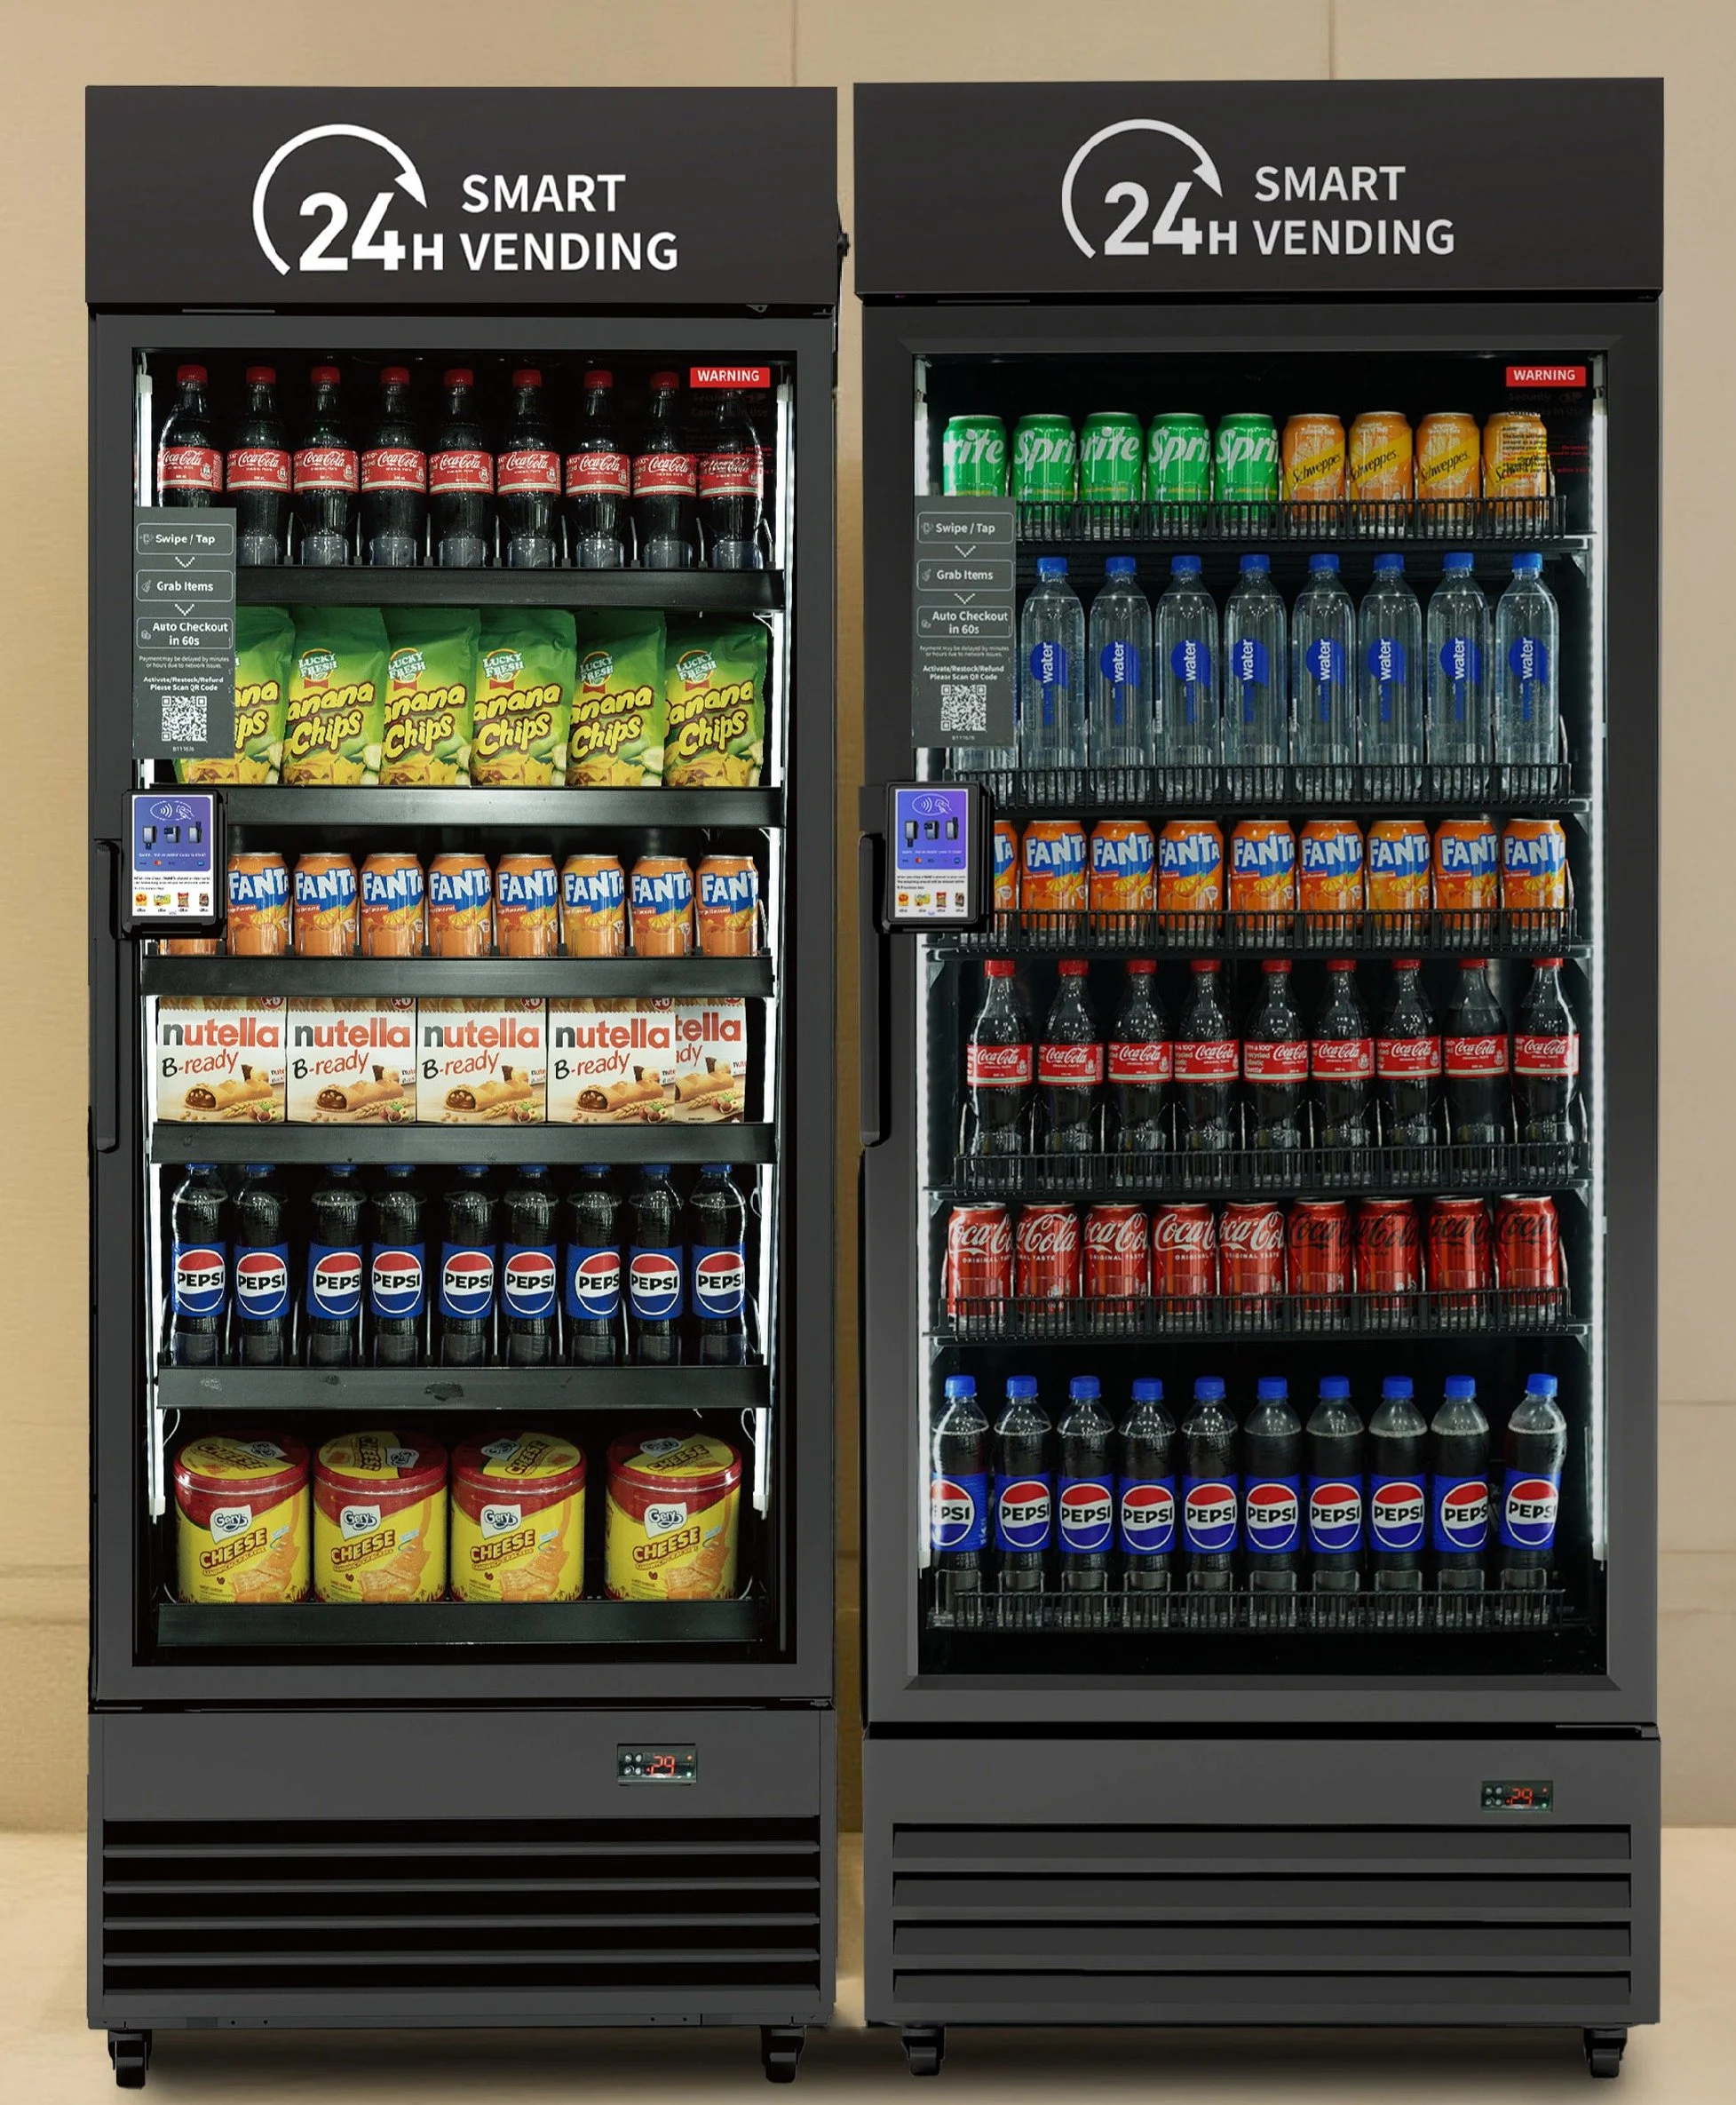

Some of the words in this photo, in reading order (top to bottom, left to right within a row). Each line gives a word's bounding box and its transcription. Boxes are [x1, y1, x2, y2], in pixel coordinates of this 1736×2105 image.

[461, 174, 626, 214] SMART
[1254, 166, 1407, 202] SMART
[298, 191, 444, 272] 24H
[1103, 181, 1238, 256] 24H
[460, 232, 678, 272] VENDING
[1252, 218, 1455, 256] VENDING
[697, 369, 760, 382] WARNING
[1513, 369, 1576, 381] WARNING
[1014, 430, 1076, 471] Spri
[1147, 429, 1210, 470] Spri
[1217, 429, 1278, 470] Spri
[155, 534, 188, 545] Swipe
[189, 534, 194, 545] /
[195, 535, 216, 545] Tap
[935, 522, 968, 535] Swipe
[970, 522, 975, 535] /
[977, 523, 995, 535] Tap
[156, 580, 182, 592] Grab
[184, 581, 214, 592] Items
[936, 569, 962, 580] Grab
[963, 570, 994, 580] Items
[152, 622, 178, 632] Auto
[179, 622, 228, 632] Checkout
[931, 611, 957, 622] Auto
[959, 611, 1009, 622] Checkout
[948, 624, 959, 634] in
[961, 624, 979, 634] 60s
[169, 635, 179, 646] in
[182, 635, 200, 646] 60s
[298, 653, 336, 667] LUCKY
[300, 662, 338, 679] FRESH
[388, 651, 424, 671] LUCKY
[389, 662, 426, 679] FRESH
[482, 652, 522, 669] LUCKY
[485, 661, 525, 679] FRESH
[579, 655, 613, 673] LUCKY
[580, 664, 614, 682] FRESH
[675, 652, 712, 671] LUCKY
[678, 661, 717, 680] FRESH
[1042, 642, 1053, 684] water
[1114, 641, 1125, 683] water
[1185, 639, 1197, 682] water
[1242, 639, 1254, 681] water
[1320, 639, 1331, 680] water
[1380, 639, 1391, 680] water
[1455, 638, 1466, 680] water
[1522, 637, 1534, 680] water
[287, 681, 374, 721] anana
[384, 685, 466, 726] anana
[475, 684, 560, 722] anana
[571, 686, 654, 725] anana
[292, 710, 364, 758] Chips
[384, 712, 455, 760] Chips
[477, 711, 551, 757] Chips
[571, 713, 642, 762] Chips
[678, 709, 749, 759] Chips
[163, 1017, 279, 1047] nutella
[295, 1017, 410, 1047] nutella
[424, 1017, 540, 1048] nutella
[555, 1018, 670, 1048] nutella
[675, 1012, 741, 1042] tella
[162, 1048, 239, 1077] B-ready
[292, 1049, 369, 1079] B-ready
[422, 1050, 499, 1079] B-ready
[554, 1052, 630, 1079] B-ready
[238, 1272, 286, 1290] PEPSI
[373, 1272, 420, 1289] PEPSI
[506, 1275, 554, 1289] PEPSI
[579, 1275, 620, 1290] PEPS
[631, 1275, 677, 1290] PEPSI
[941, 1506, 970, 1521] PSI
[1061, 1505, 1111, 1523] PEPSI
[1123, 1506, 1172, 1524] PEPSI
[1248, 1506, 1296, 1522] PEPSI
[1312, 1506, 1359, 1522] PEPSI
[1445, 1503, 1487, 1522] PEPS
[200, 1528, 267, 1569] CHEESE
[330, 1528, 396, 1565] CHEESE
[470, 1529, 535, 1564] CHEESE
[632, 1526, 701, 1563] CHEESE
